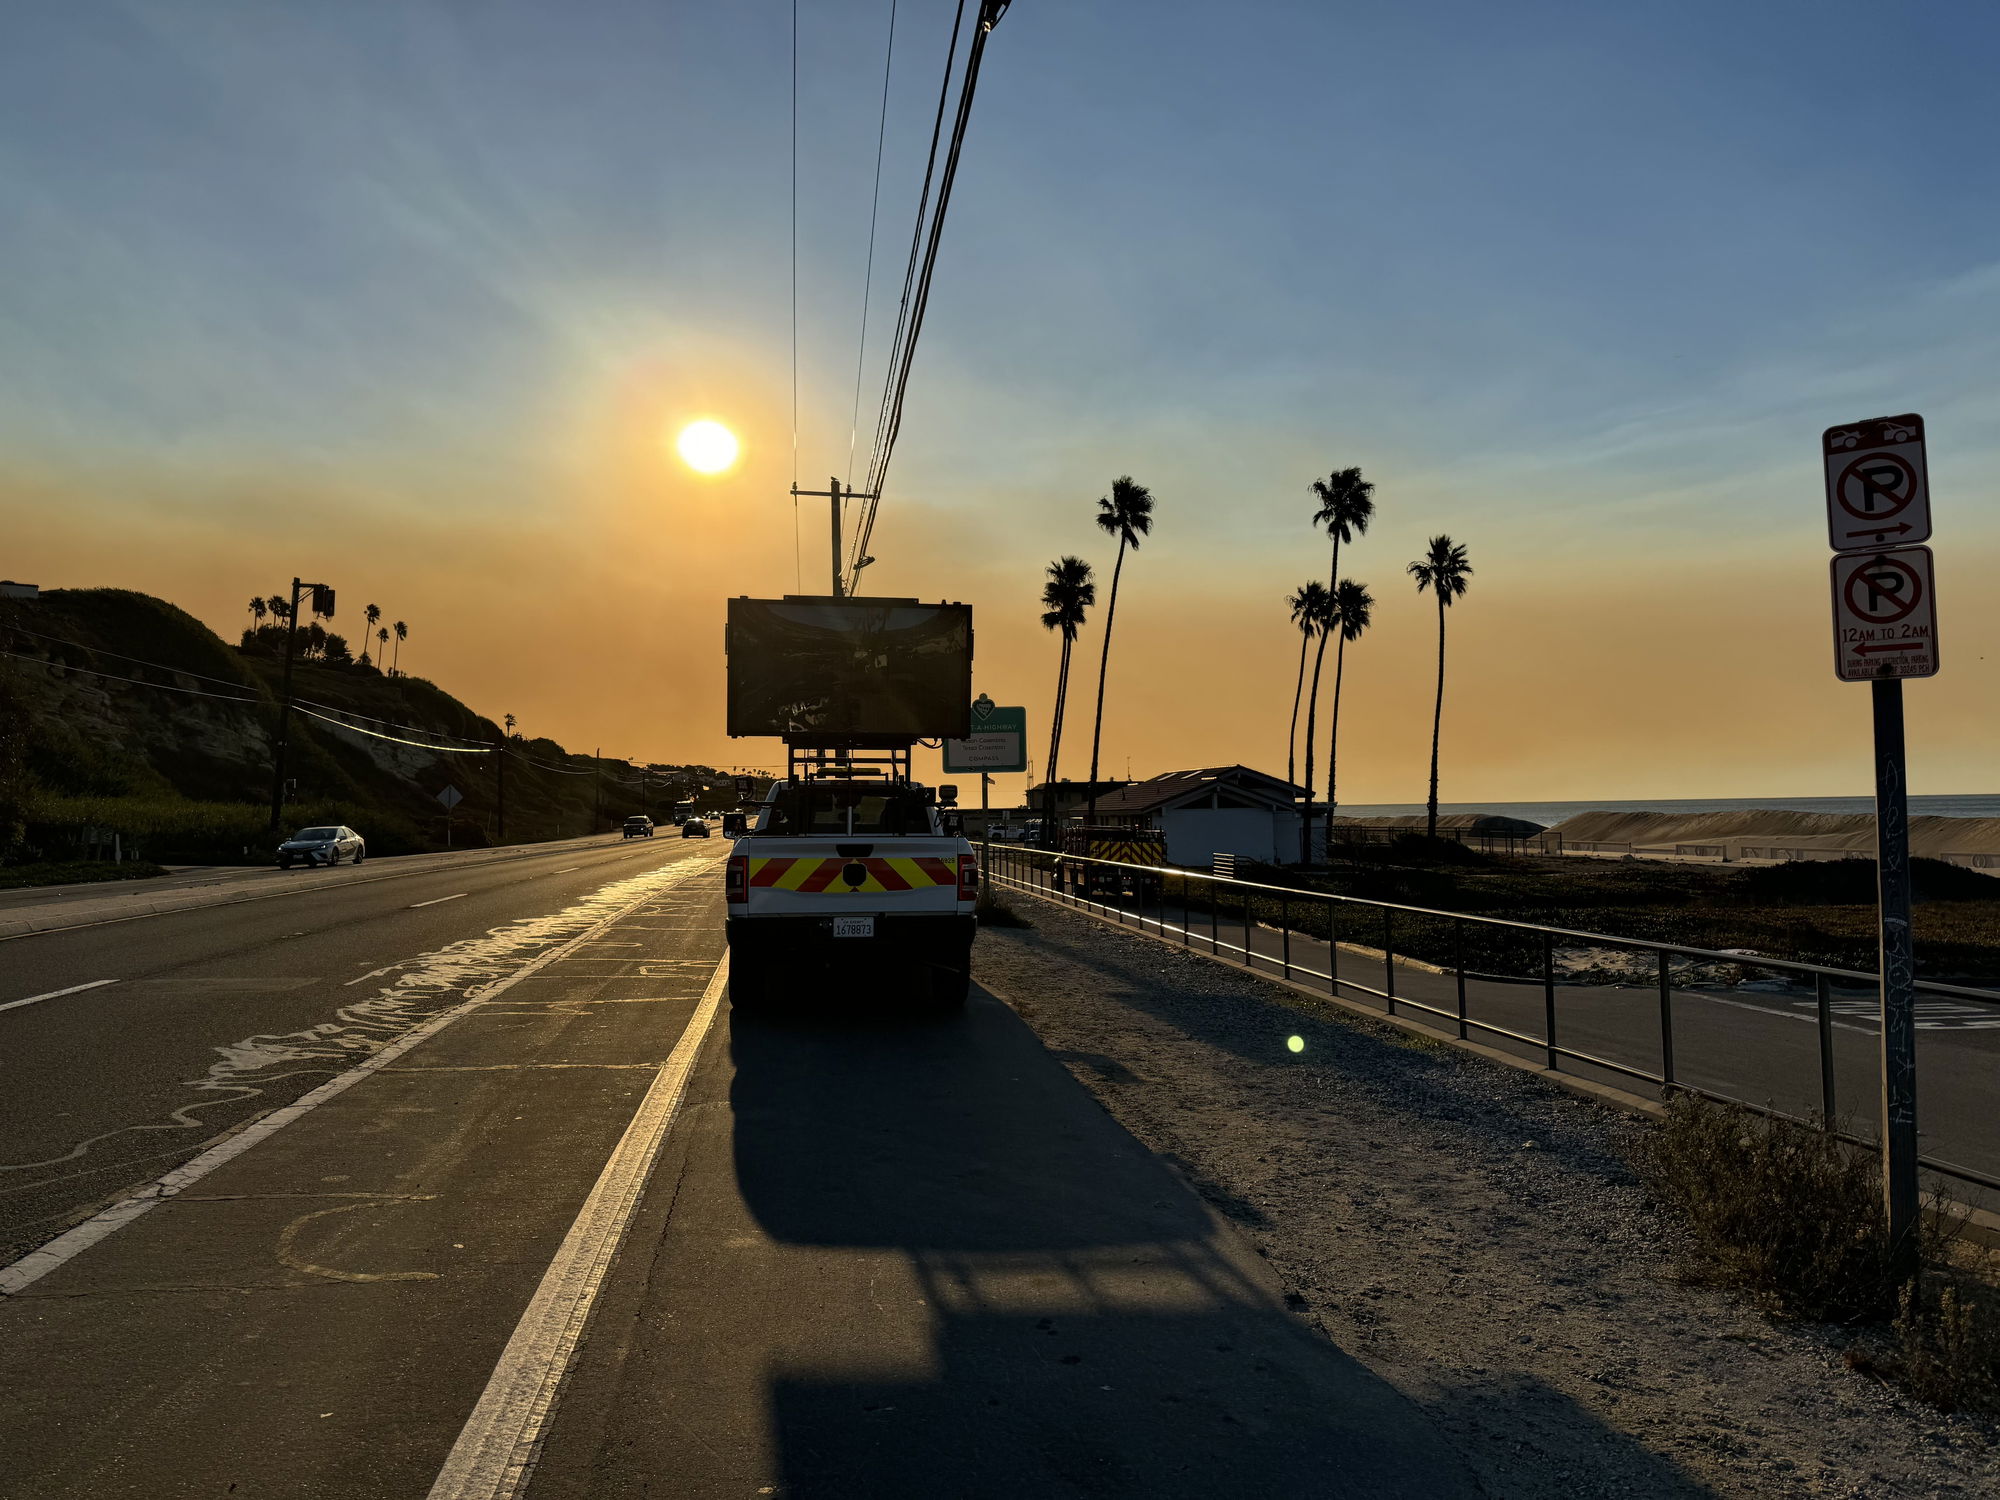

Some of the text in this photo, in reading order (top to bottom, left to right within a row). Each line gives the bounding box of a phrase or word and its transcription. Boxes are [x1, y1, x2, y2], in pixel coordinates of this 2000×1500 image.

[1843, 624, 1928, 642] 12AM TO 2AM
[1918, 663, 1930, 673] PCH
